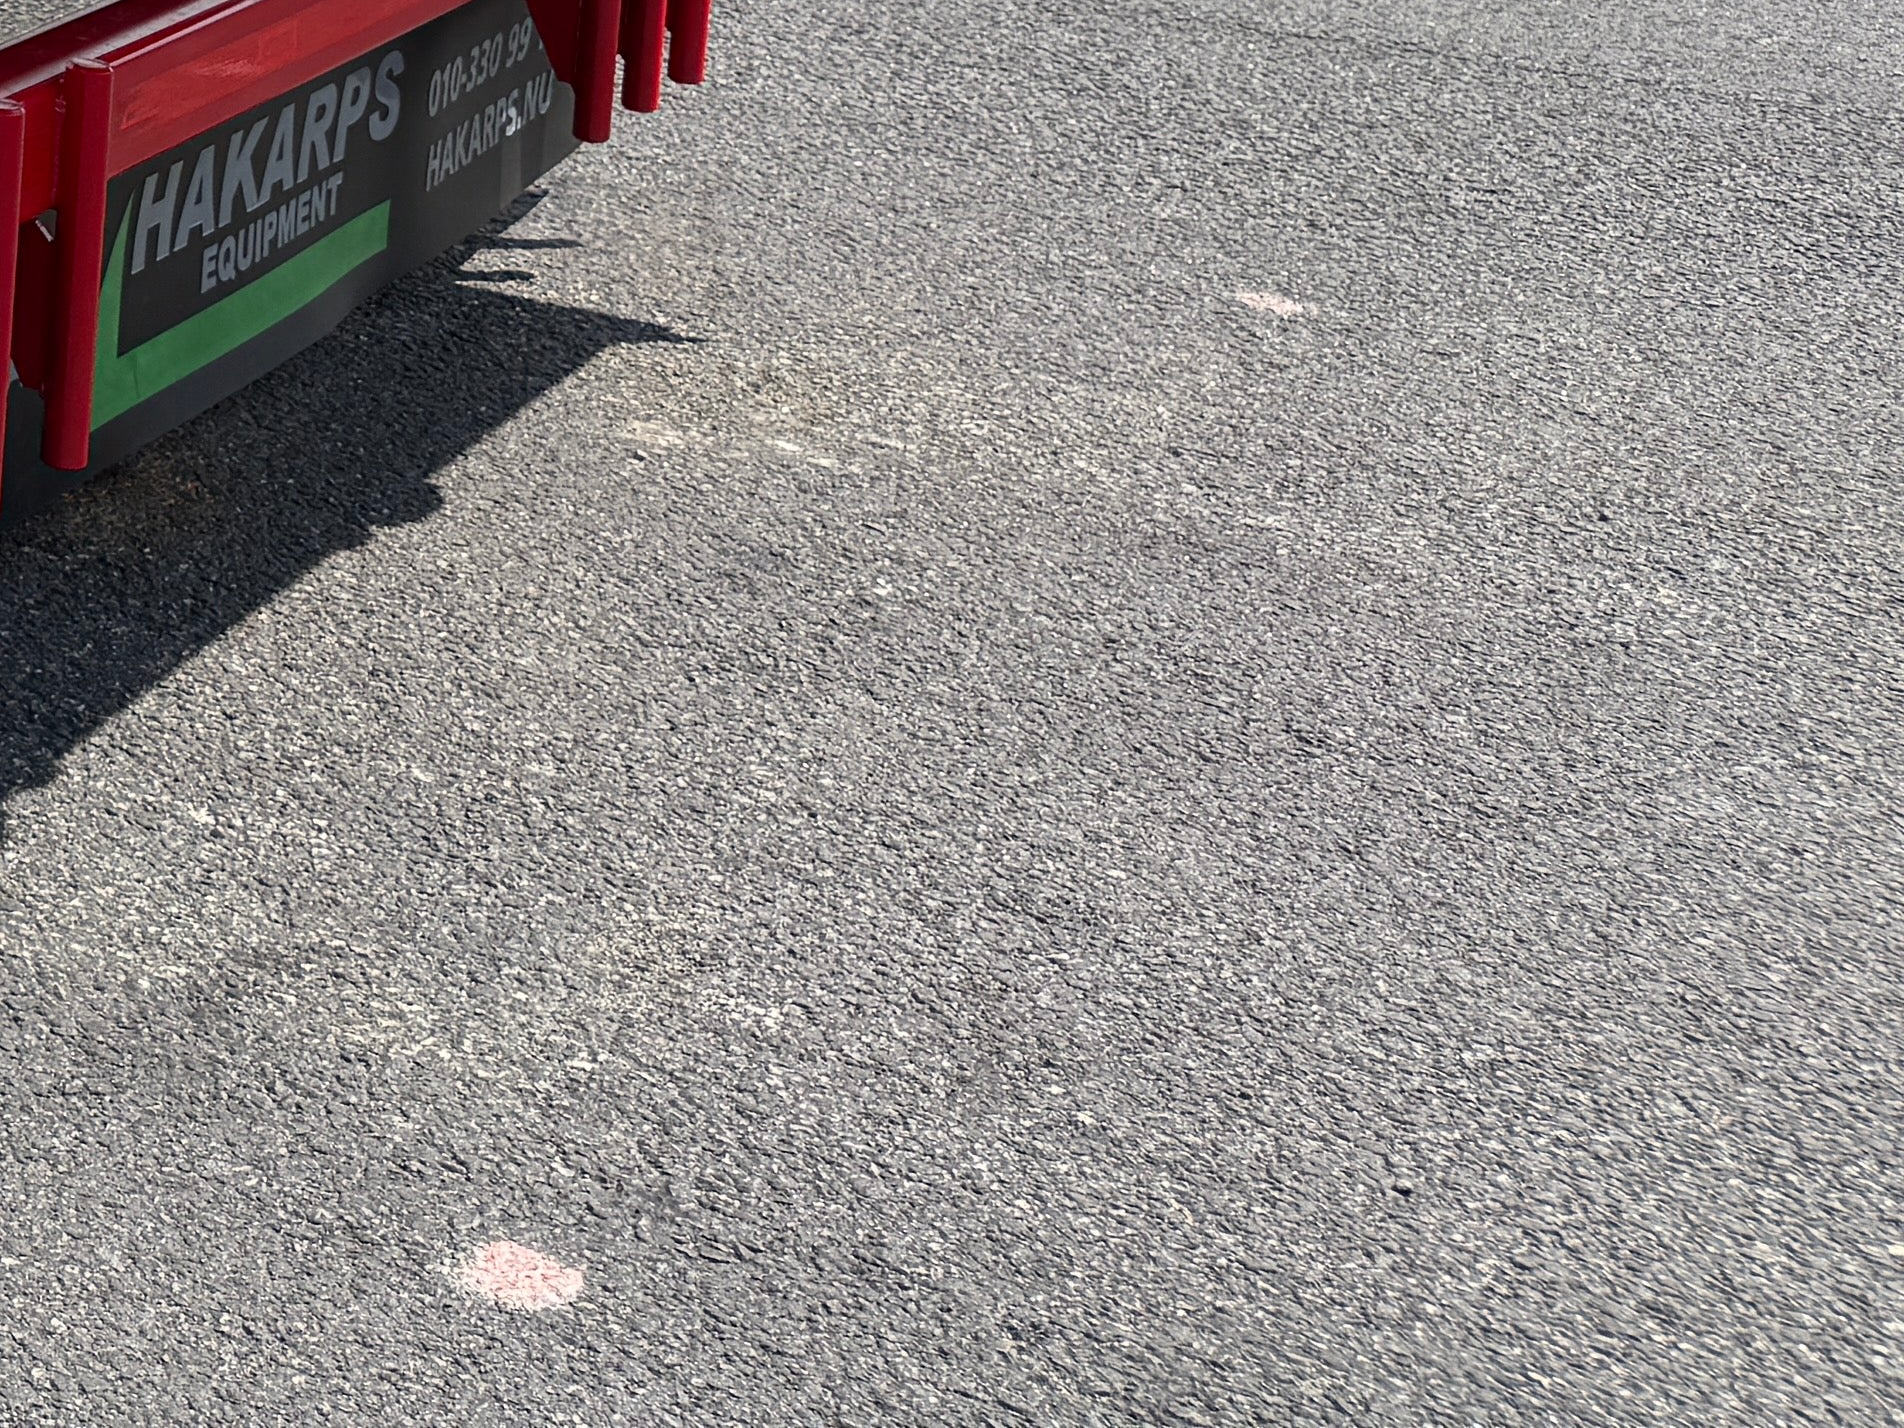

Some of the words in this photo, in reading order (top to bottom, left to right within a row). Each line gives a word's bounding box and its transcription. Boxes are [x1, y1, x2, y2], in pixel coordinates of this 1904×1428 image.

[428, 32, 504, 118] 010-330
[506, 16, 533, 68] 99
[131, 49, 405, 276] HAKARPS
[426, 68, 555, 192] HAKARPS.NU
[201, 170, 344, 294] EQUIPMENT
